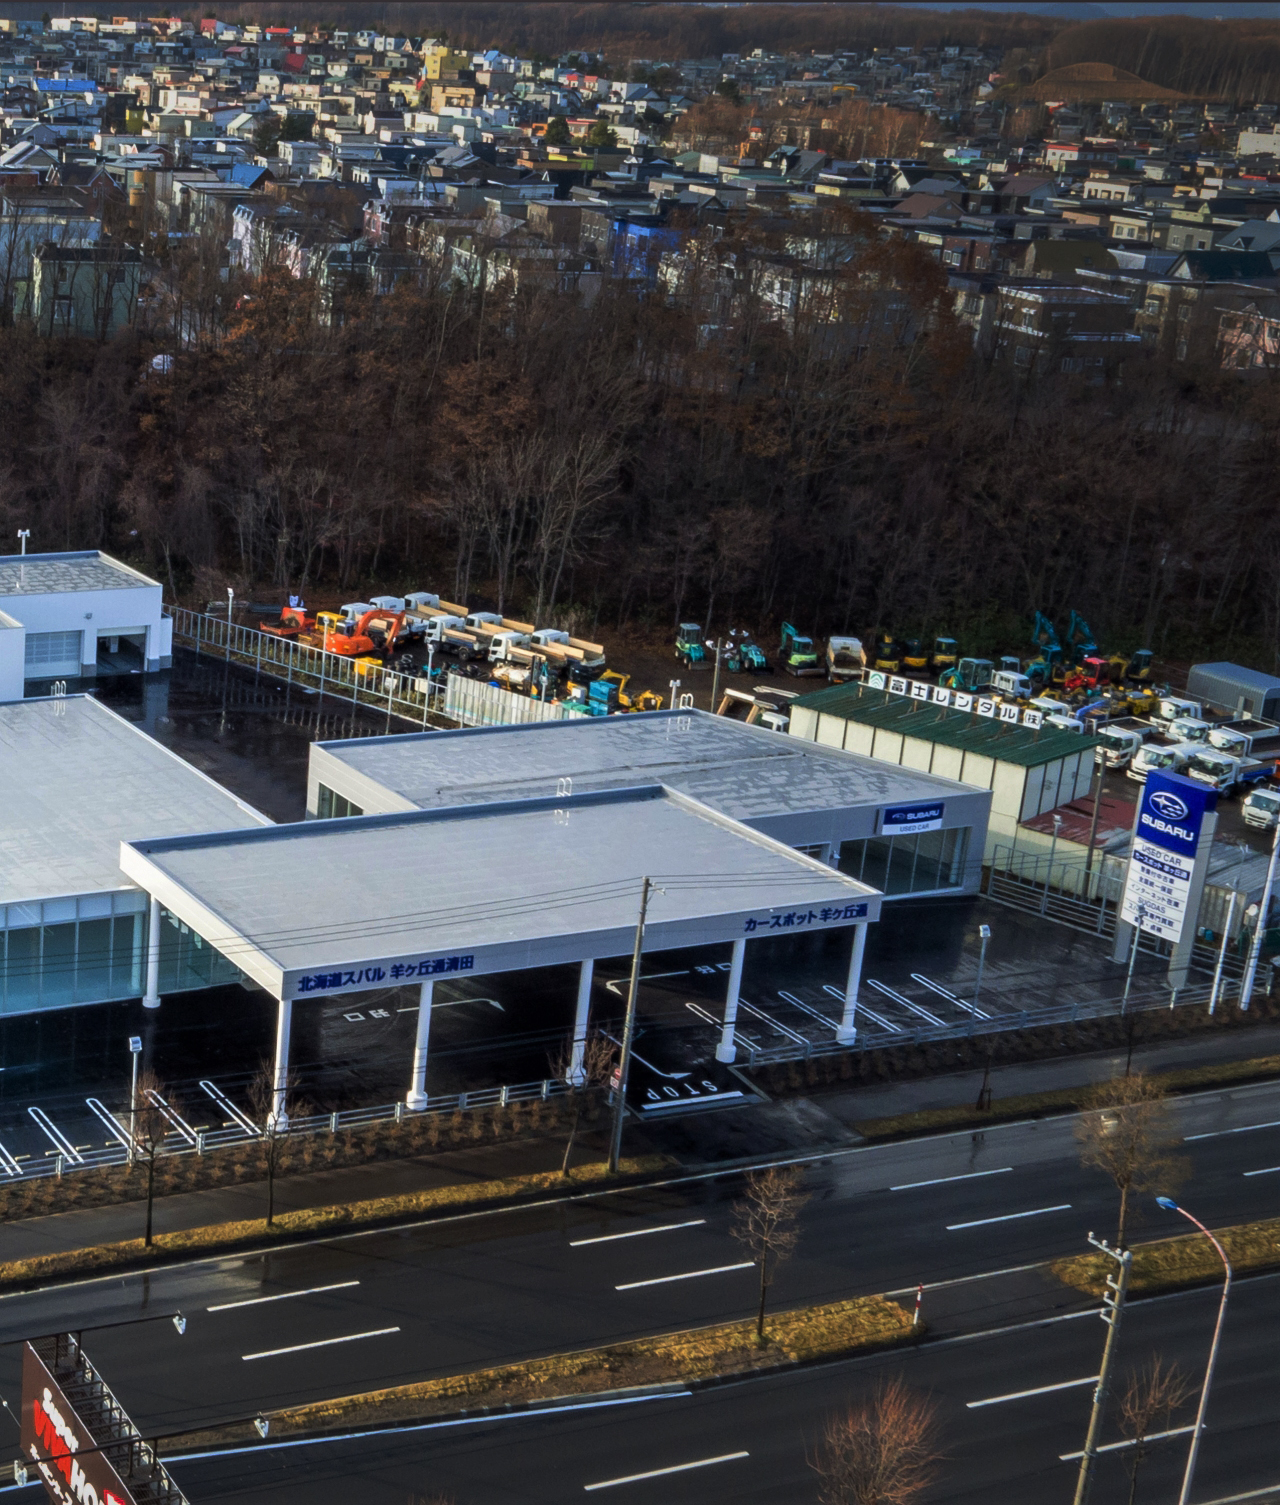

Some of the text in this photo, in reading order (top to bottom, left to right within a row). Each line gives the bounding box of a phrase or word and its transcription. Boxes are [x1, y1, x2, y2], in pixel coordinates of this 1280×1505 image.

[906, 809, 940, 820] SUBARU
[1141, 813, 1194, 841] SUBARU
[1141, 844, 1182, 866] USED CAR
[744, 910, 818, 932] カースポット
[298, 967, 386, 992] 北海道スバル
[646, 1080, 718, 1100] STOP
